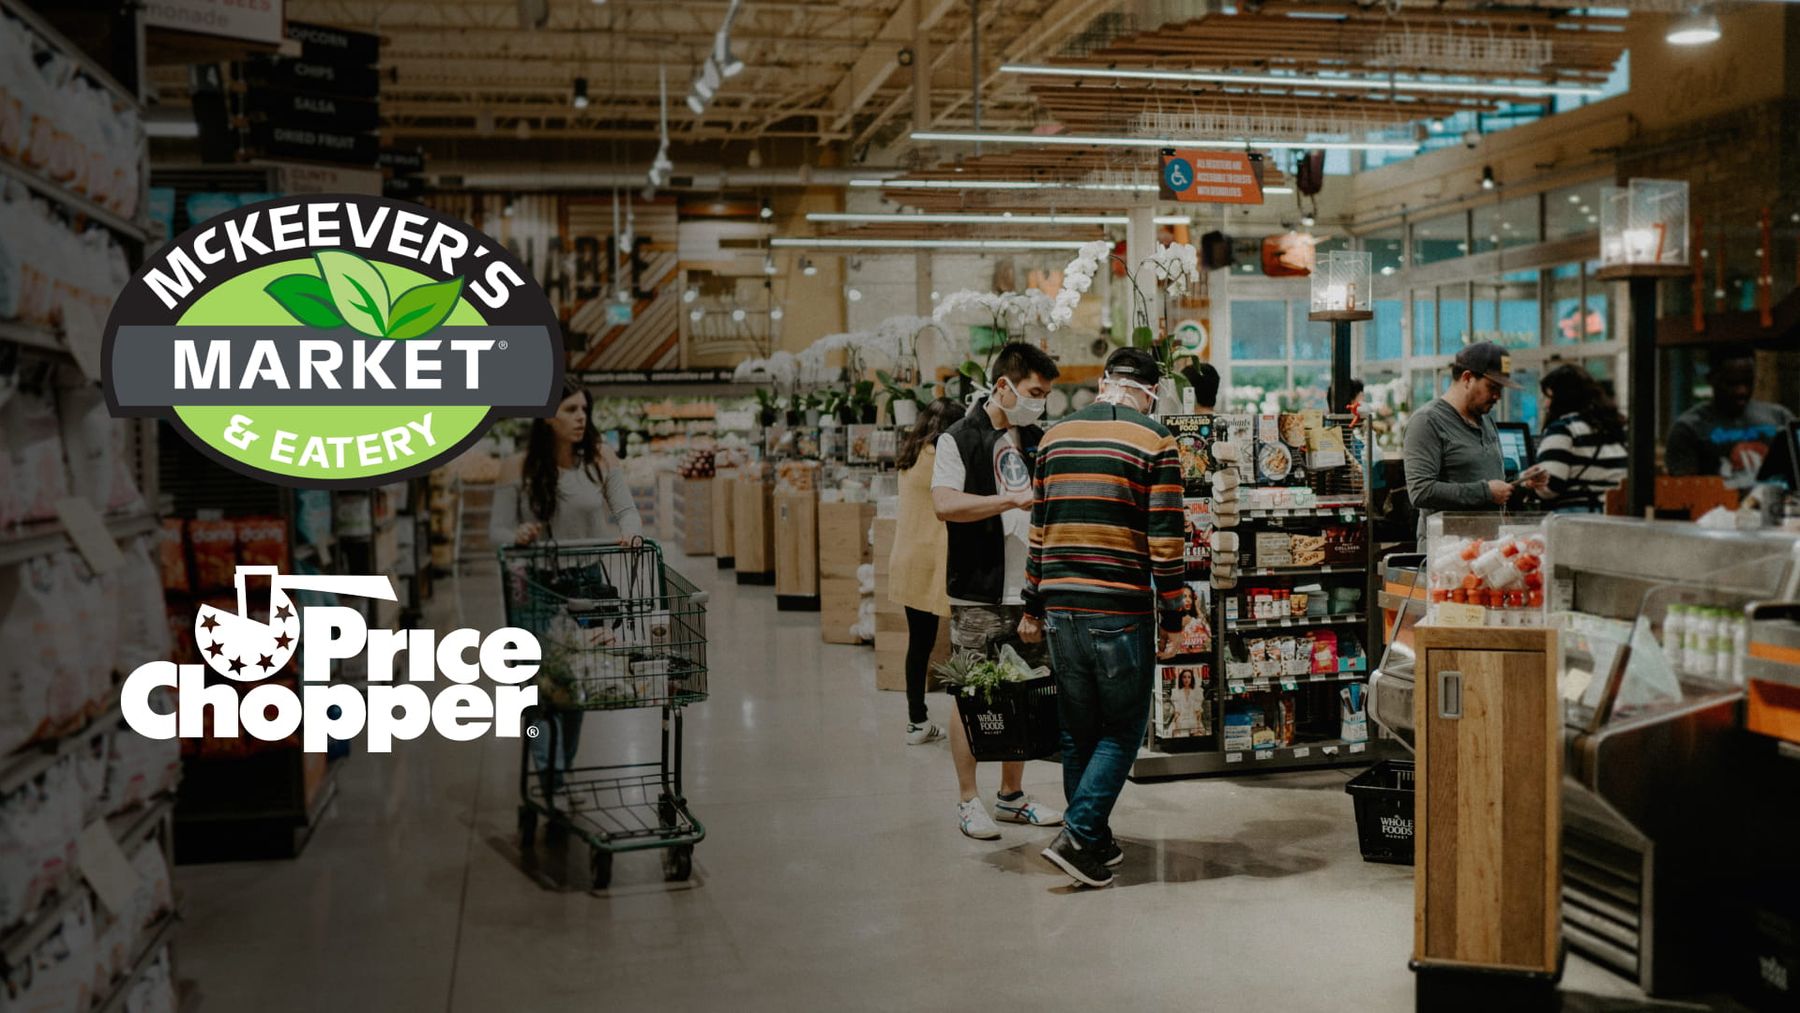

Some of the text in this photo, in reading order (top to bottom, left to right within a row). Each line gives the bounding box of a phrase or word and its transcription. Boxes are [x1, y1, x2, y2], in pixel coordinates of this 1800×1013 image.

[289, 26, 348, 48] OPCORN
[293, 62, 336, 81] CHIPS
[293, 95, 337, 115] SALSA
[272, 127, 356, 151] DRIED FRUIT
[1179, 424, 1199, 432] FOOD
[976, 713, 1004, 723] WHOLE
[980, 721, 1005, 731] FOODS
[1380, 816, 1414, 828] WHOLE
[1382, 825, 1414, 836] FOODS
